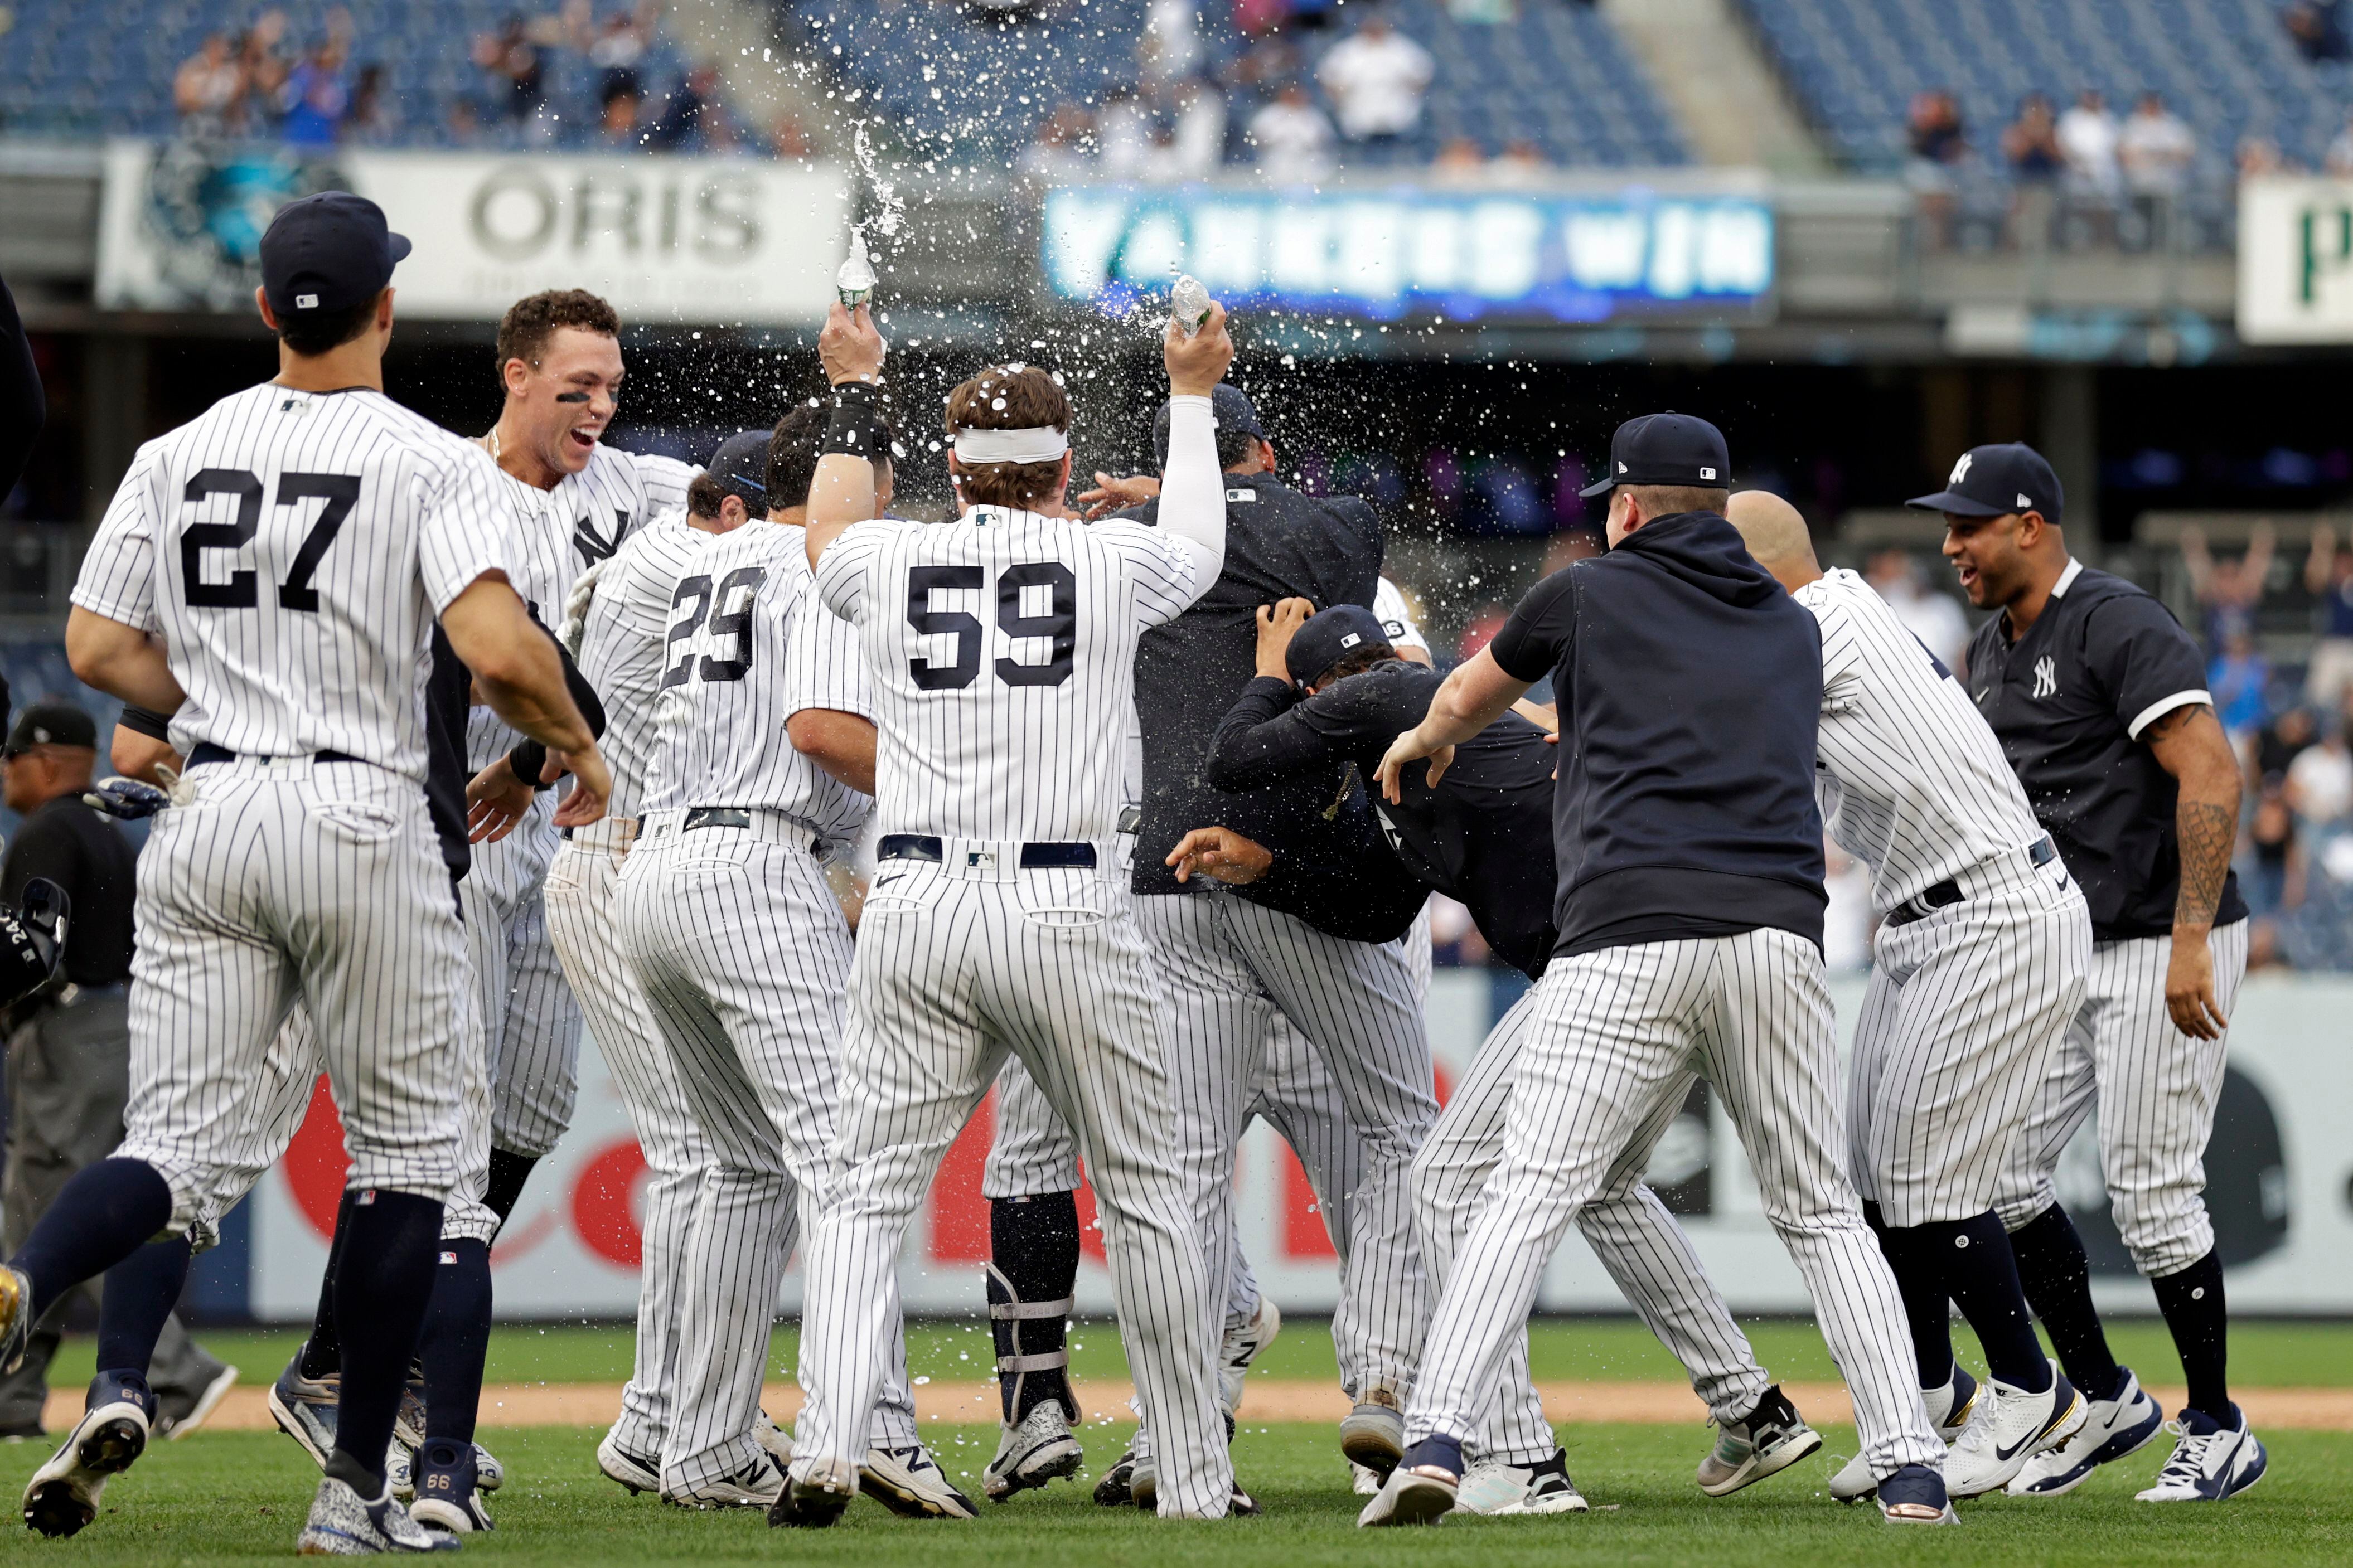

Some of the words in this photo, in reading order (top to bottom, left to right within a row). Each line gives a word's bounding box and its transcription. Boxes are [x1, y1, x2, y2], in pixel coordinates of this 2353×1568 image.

[468, 163, 767, 265] ORIS
[181, 468, 362, 613] 27
[660, 566, 767, 691] 29
[907, 562, 1075, 690] 59
[2032, 654, 2056, 699] NY
[6, 920, 27, 944] 24
[427, 1474, 451, 1490] 66
